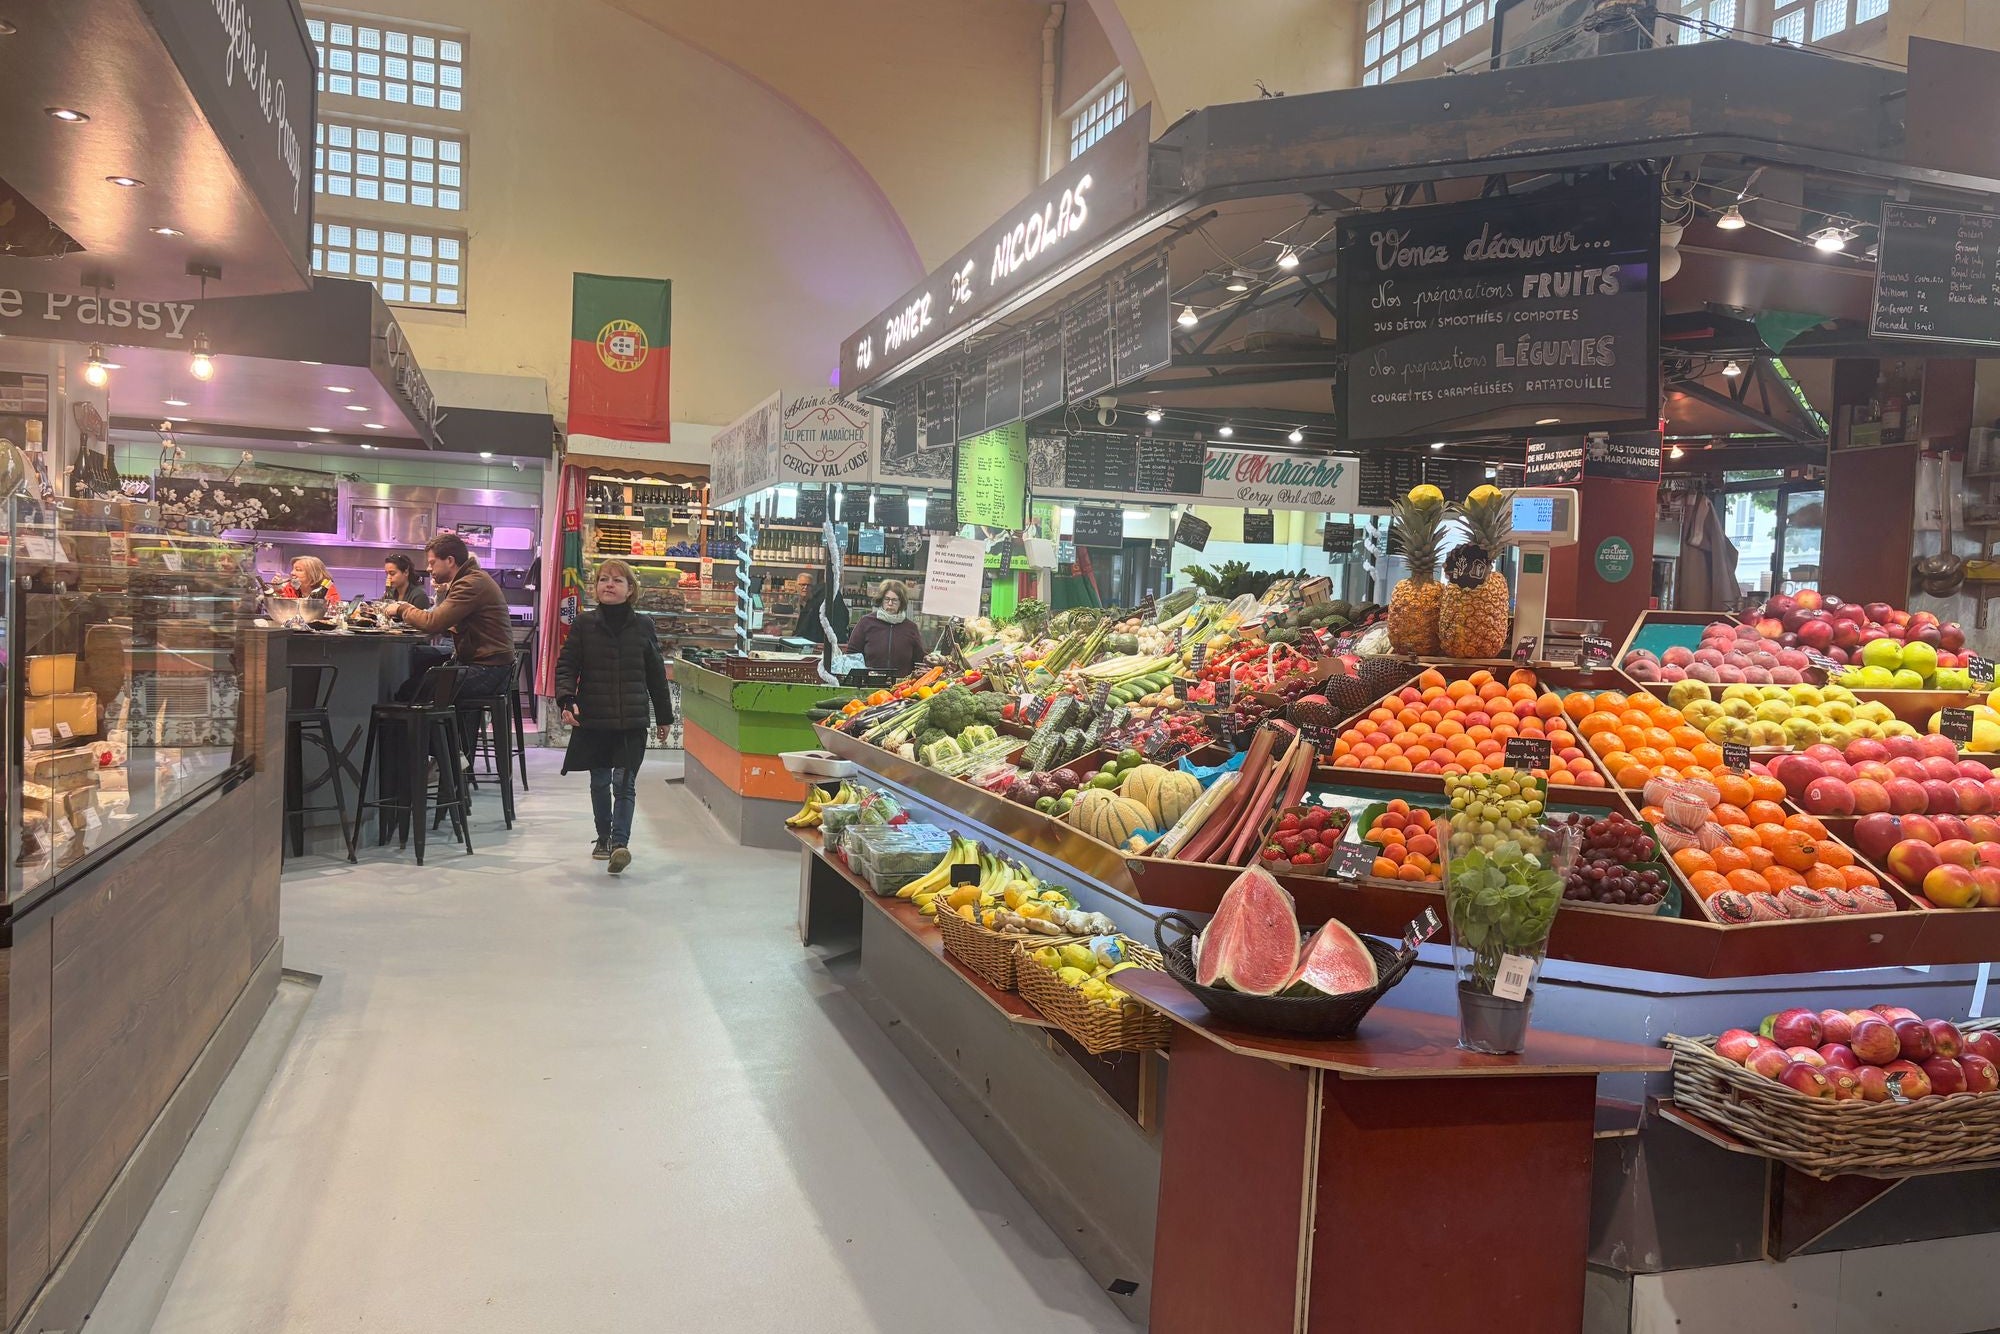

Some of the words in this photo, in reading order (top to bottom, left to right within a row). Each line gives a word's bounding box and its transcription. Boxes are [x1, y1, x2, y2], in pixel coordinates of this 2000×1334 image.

[259, 50, 273, 123] de
[275, 79, 301, 215] Passy
[1370, 229, 1449, 270] Venez
[856, 336, 872, 372] AU
[885, 292, 932, 356] PANIER
[949, 259, 975, 314] DE
[990, 173, 1093, 286] NICOLAS
[1371, 280, 1401, 309] Nos
[43, 293, 195, 339] Passy
[1374, 322, 1393, 332] JUS
[1396, 317, 1427, 331] DÉTOX
[1513, 309, 1579, 322] COMPOTES
[1369, 348, 1396, 377] Nos
[1496, 333, 1616, 367] LÉGUMES
[784, 395, 818, 420] Alain
[784, 429, 795, 442] AU
[796, 429, 816, 442] PETIT
[1527, 454, 1535, 462] DE
[1544, 451, 1555, 460] PAS
[1555, 448, 1583, 459] TOUCHER
[1529, 443, 1546, 452] MERCI
[1610, 444, 1624, 453] PAS
[1626, 446, 1660, 456] TOUCHER
[783, 454, 819, 477] CERGY
[821, 464, 842, 477] VAL
[1204, 452, 1237, 481] etit
[1235, 453, 1344, 488] Maraîcher
[1532, 465, 1539, 473] LA
[1540, 459, 1582, 471] MARCHANDISE
[1604, 455, 1660, 467] MARCHANDISE
[1237, 486, 1274, 506] Cergy
